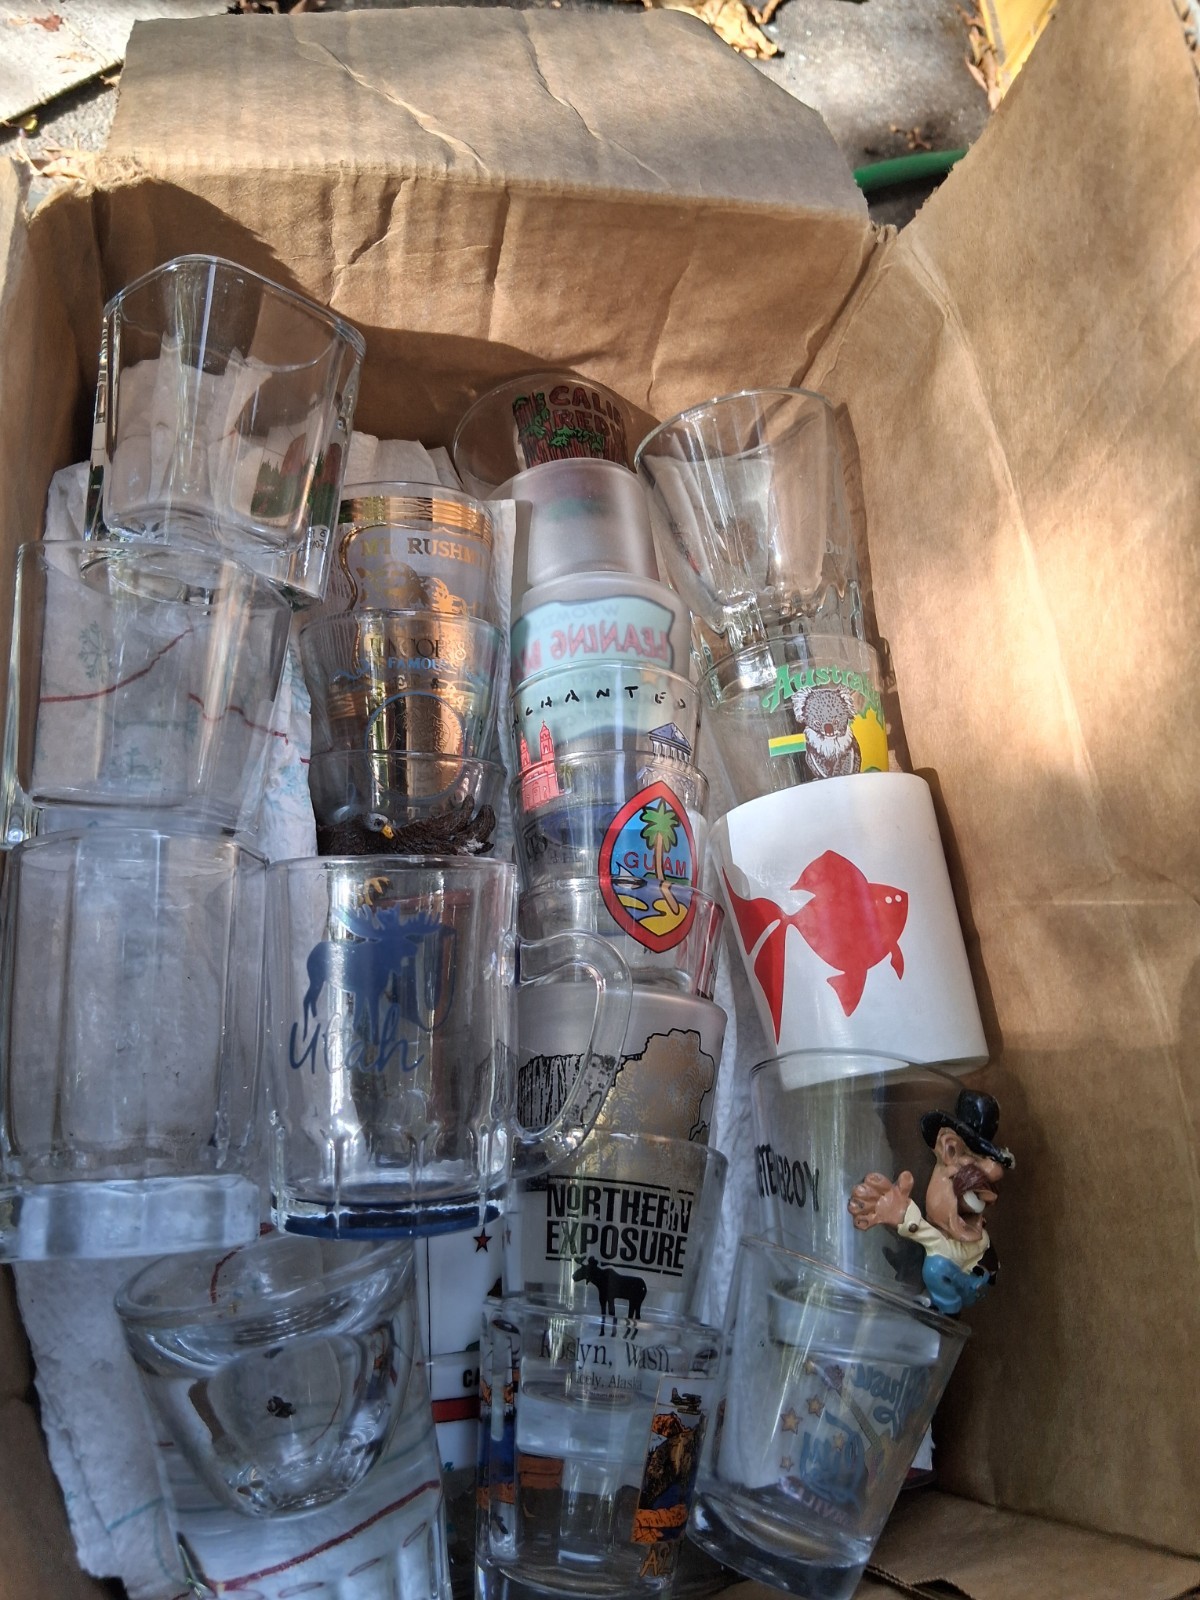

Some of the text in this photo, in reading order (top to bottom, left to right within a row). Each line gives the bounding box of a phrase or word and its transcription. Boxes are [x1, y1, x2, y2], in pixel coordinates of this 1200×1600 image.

[407, 537, 484, 566] RUSHM
[623, 851, 687, 876] GUAM
[289, 1002, 425, 1075] Utah
[547, 1183, 693, 1235] NORTHERN
[546, 1220, 688, 1270] EXPOSURE
